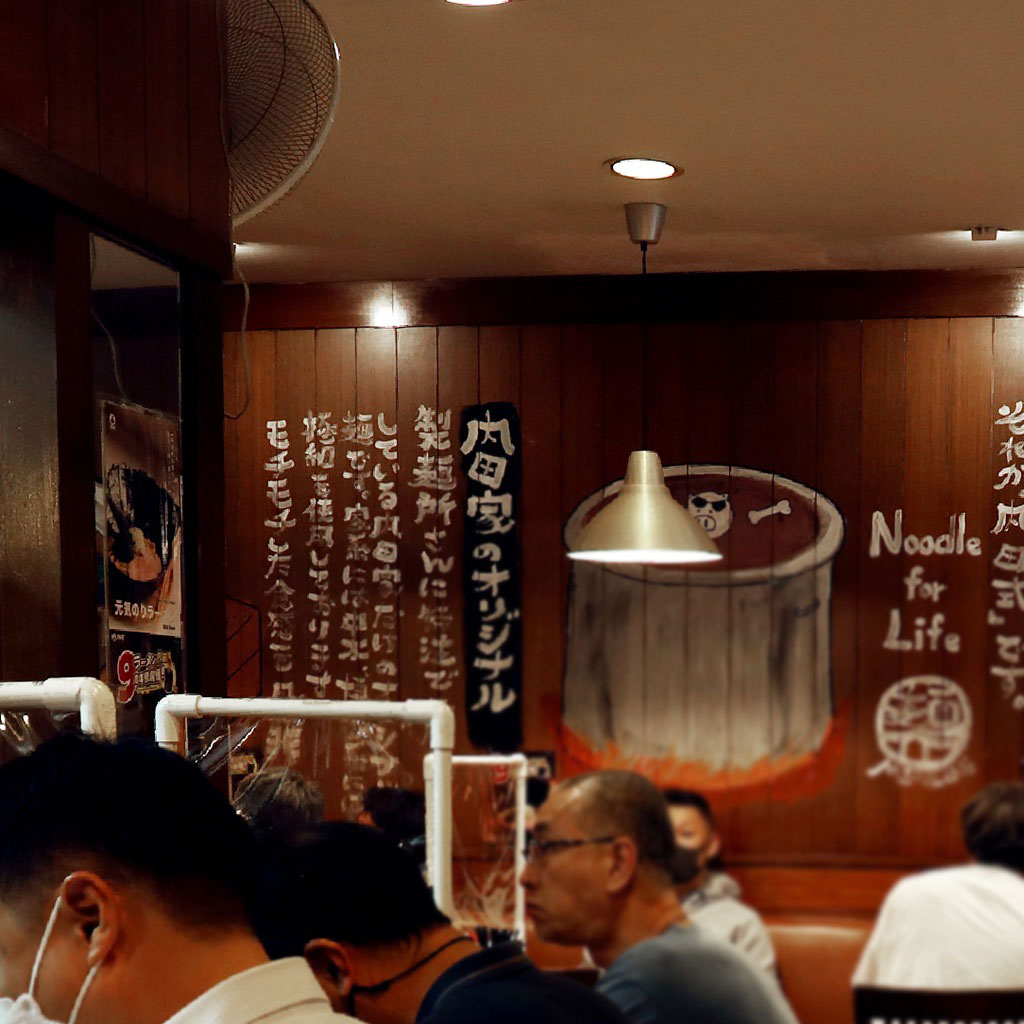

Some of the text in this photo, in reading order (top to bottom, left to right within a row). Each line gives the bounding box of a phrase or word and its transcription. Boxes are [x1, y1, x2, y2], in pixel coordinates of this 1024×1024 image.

[869, 510, 982, 558] Noodle
[460, 408, 520, 714] 内田家のオリジナル
[904, 566, 948, 602] for
[883, 609, 960, 652] Life
